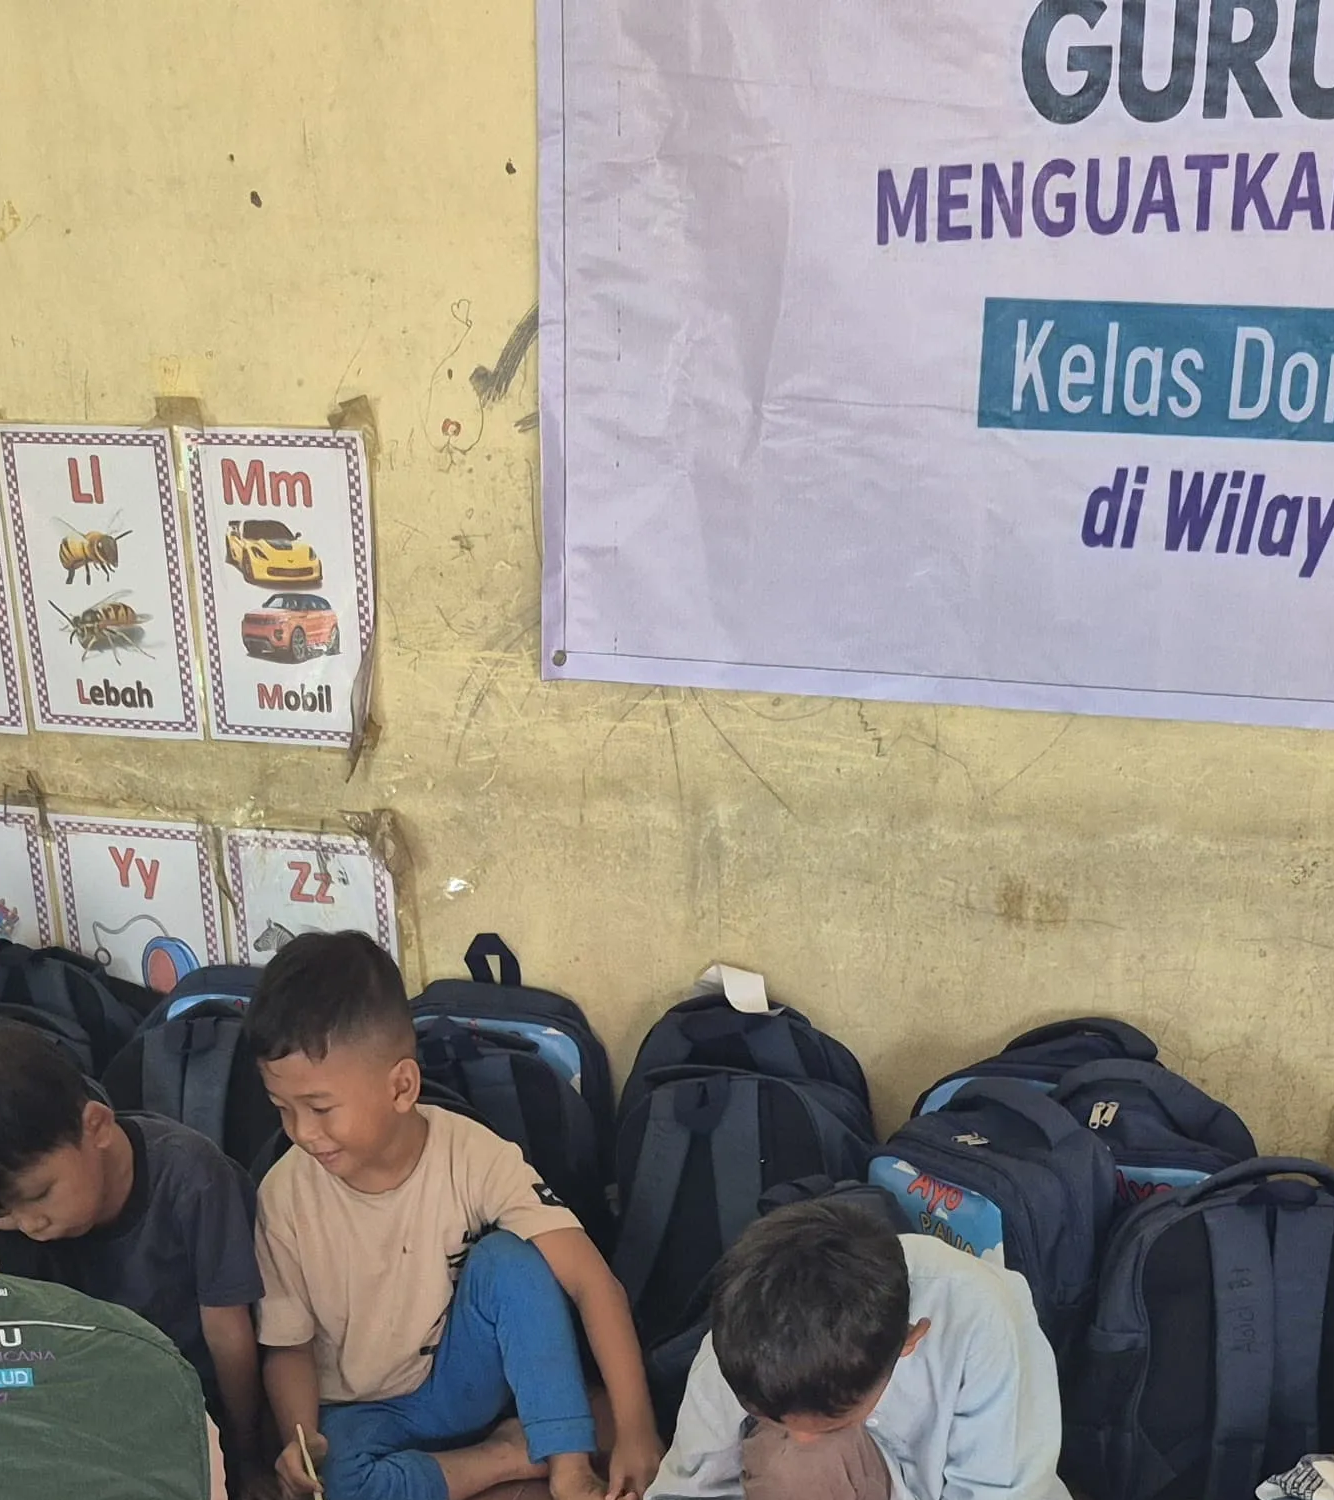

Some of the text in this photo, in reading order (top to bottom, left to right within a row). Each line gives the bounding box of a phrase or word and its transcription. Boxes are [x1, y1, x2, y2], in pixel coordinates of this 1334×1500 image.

[1012, 319, 1203, 422] Kelas
[221, 458, 313, 508] Mm
[1082, 467, 1150, 551] di
[76, 678, 153, 709] Lebah
[256, 683, 332, 715] Mobil
[108, 846, 159, 900] Yy
[287, 861, 335, 904] Zz
